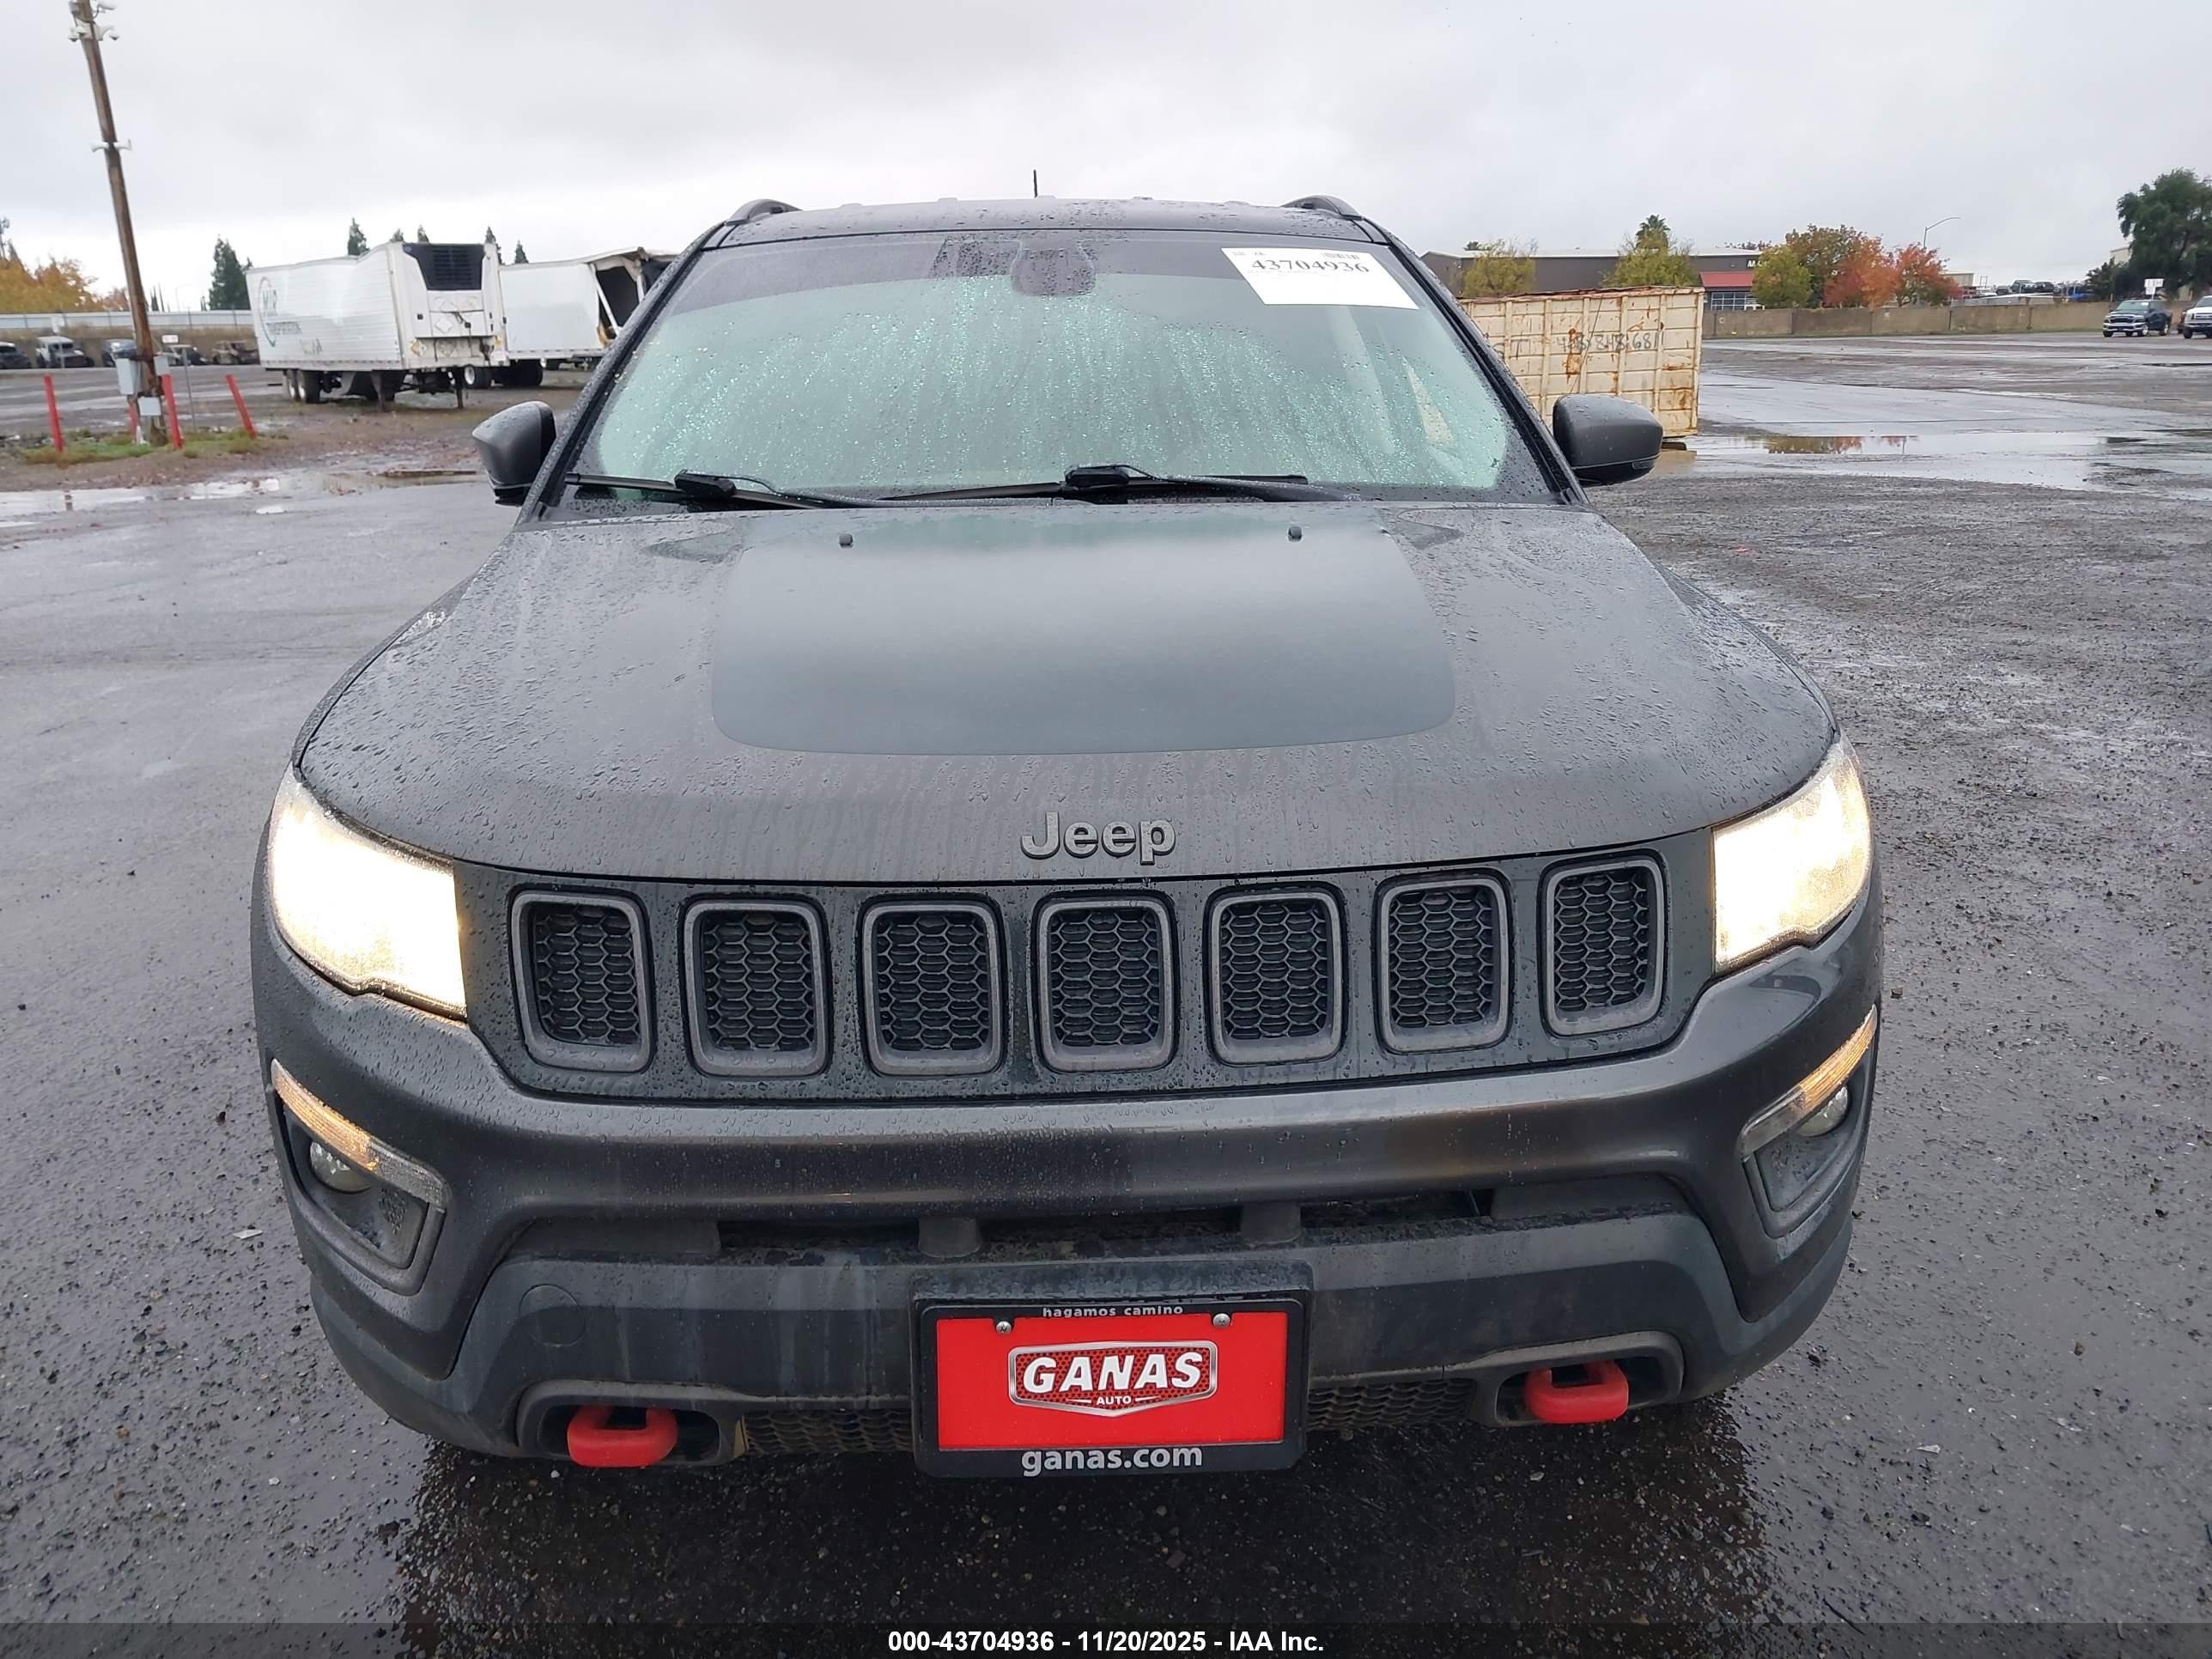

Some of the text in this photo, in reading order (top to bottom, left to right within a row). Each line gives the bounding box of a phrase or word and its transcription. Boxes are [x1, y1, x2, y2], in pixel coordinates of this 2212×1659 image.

[1251, 258, 1370, 273] 43704936
[1020, 811, 1176, 866] Jeep
[1042, 1305, 1183, 1318] hagamos camino
[1023, 1352, 1203, 1394] GANAS
[1096, 1395, 1132, 1406] AUTO
[1021, 1447, 1203, 1477] ganas.com
